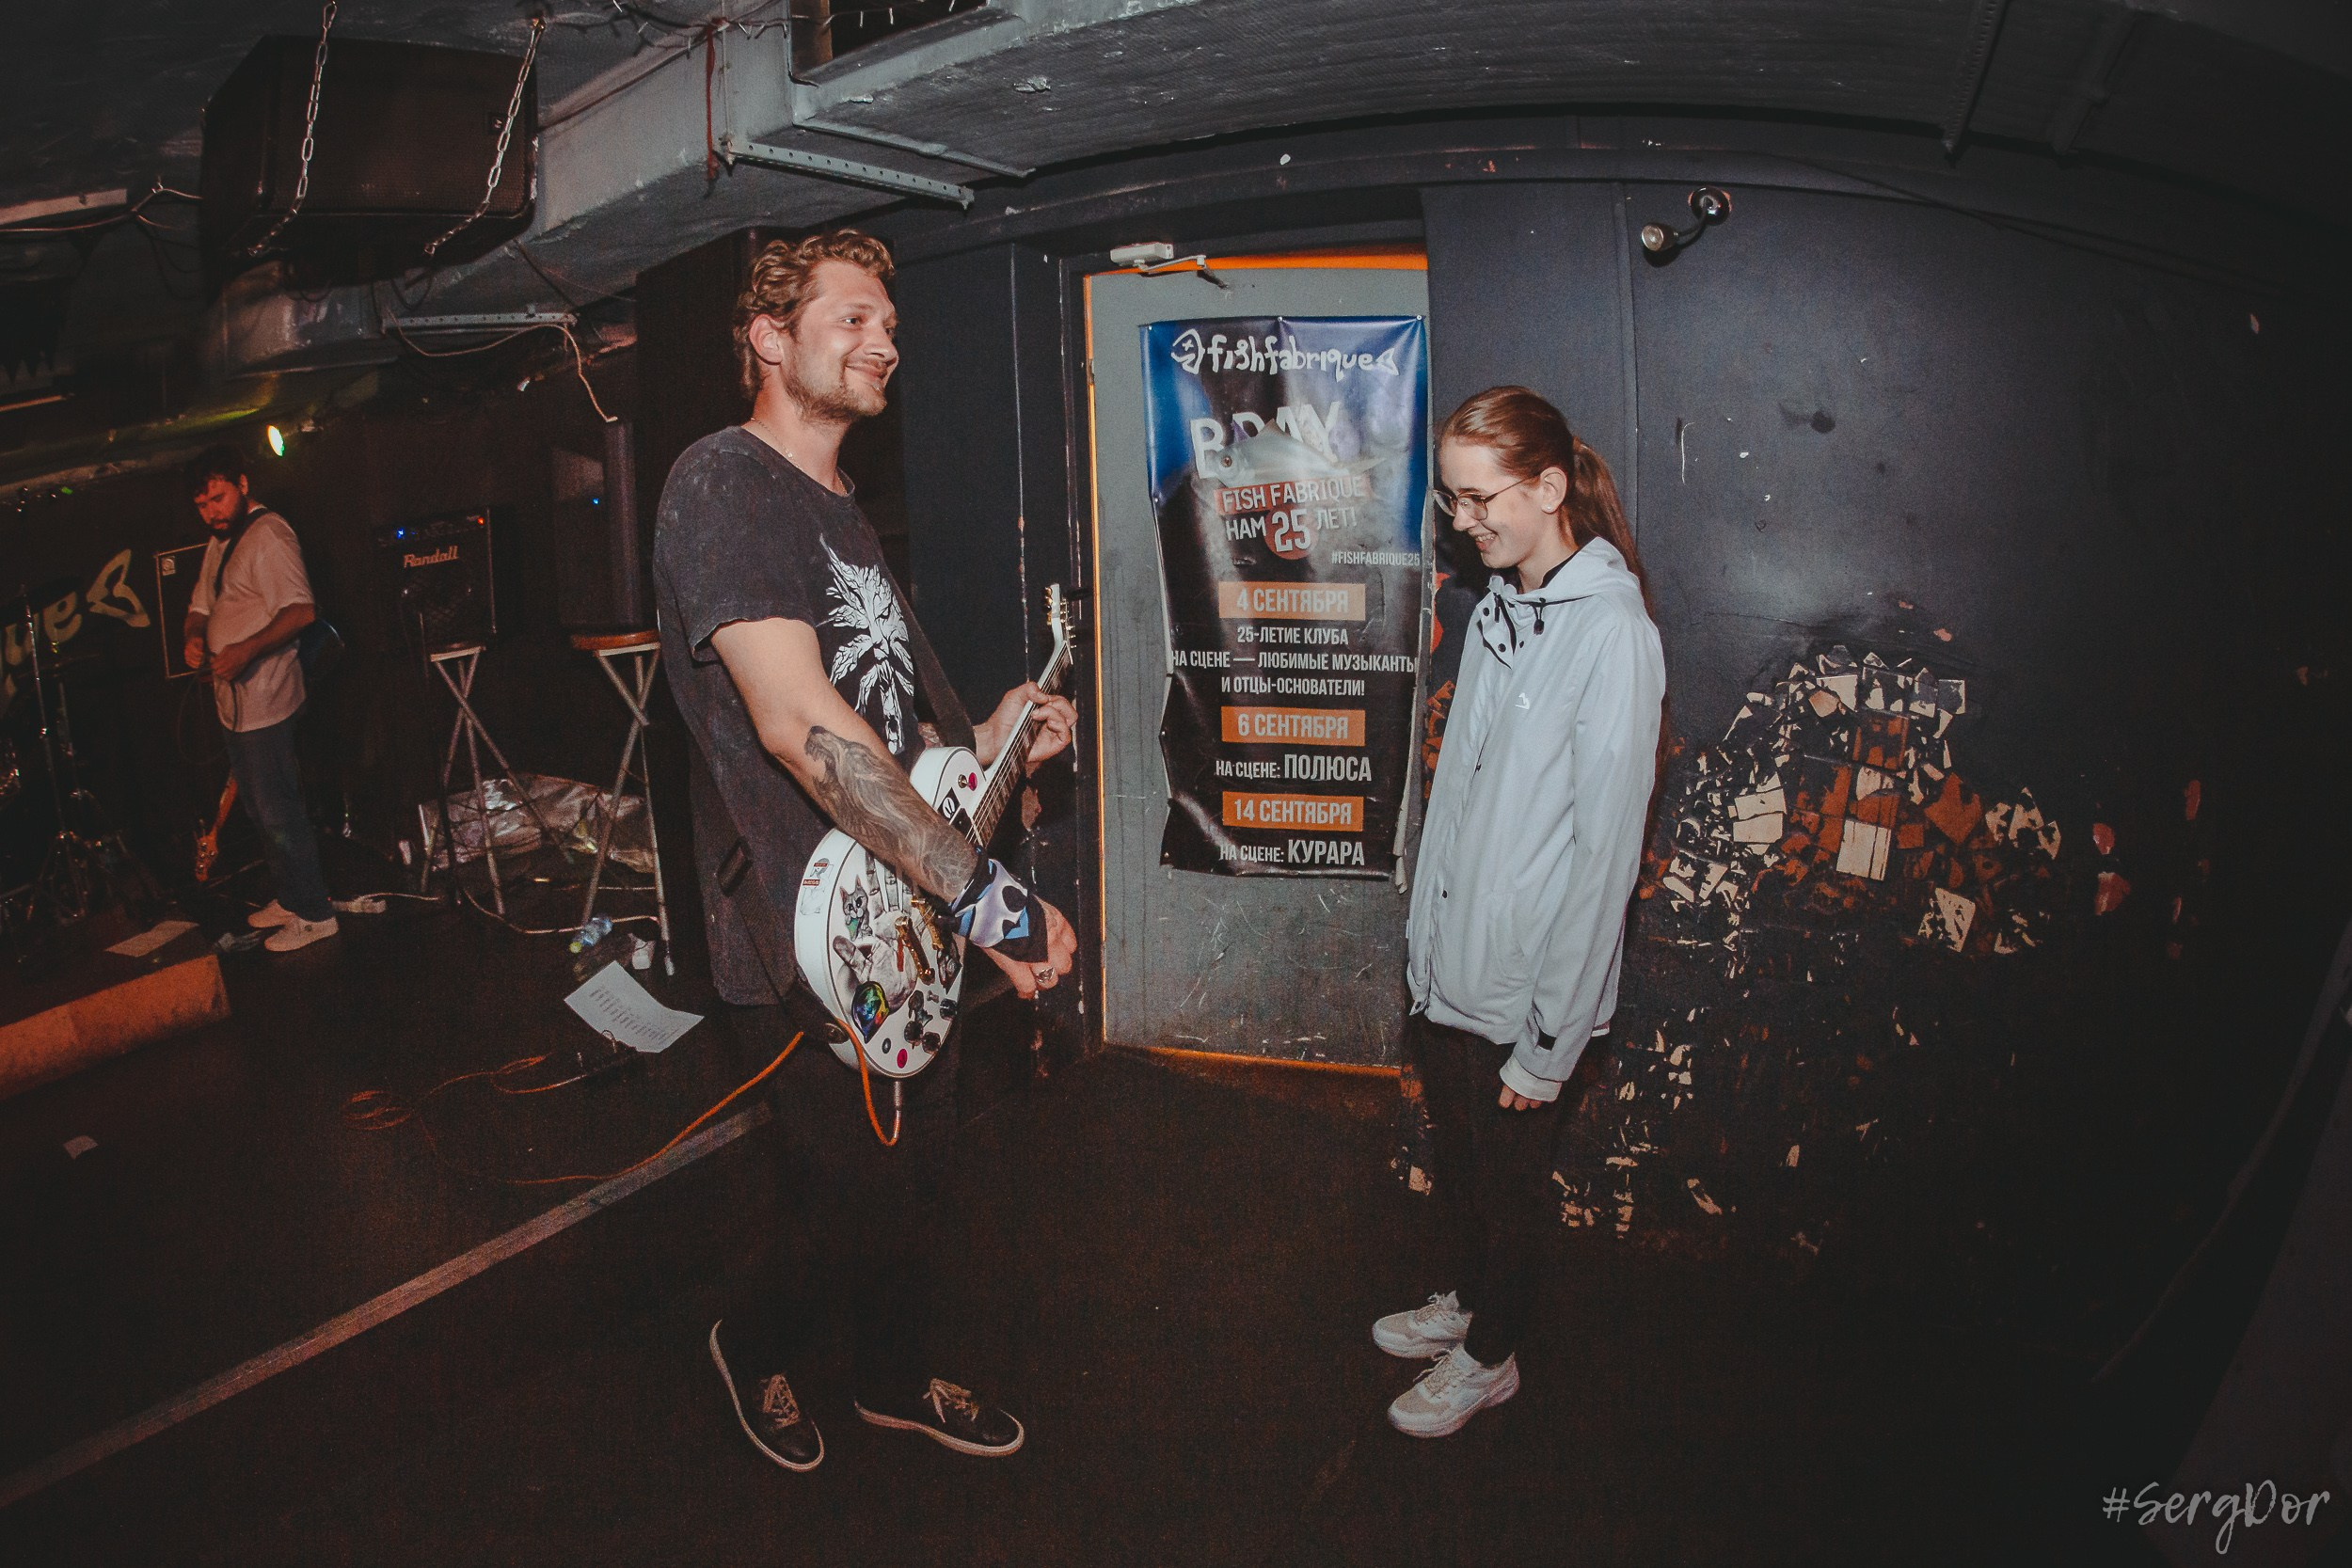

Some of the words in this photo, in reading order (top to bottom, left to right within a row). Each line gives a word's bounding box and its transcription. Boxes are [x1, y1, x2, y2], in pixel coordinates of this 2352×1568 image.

[1223, 487, 1266, 512] FISH
[1270, 475, 1365, 506] FABRIQUE
[1226, 515, 1267, 541] НАМ
[1271, 509, 1312, 552] 25
[1316, 506, 1358, 531] ЛЕТ!
[403, 545, 459, 569] Randall
[1330, 550, 1421, 566] #FISHFABRIQUE25
[1236, 587, 1248, 611] 4
[1253, 588, 1349, 613] СЕНТЯБРЯ
[1237, 626, 1301, 644] 25-ЛЕТИЕ
[1304, 627, 1349, 645] КЛУБА
[1190, 650, 1232, 669] СЦЕНЕ
[1258, 651, 1329, 671] ЛЮБИМЫЕ
[1332, 654, 1419, 673] МУЗЫКАНТЫ
[1221, 676, 1231, 693] И
[1233, 676, 1365, 696] ОТЦЫ-ОСНОВАТЕЛИ!
[1237, 713, 1250, 736] 6
[1254, 713, 1349, 739] СЕНТЯБРЯ
[1216, 760, 1233, 777] НА
[1235, 761, 1281, 780] СЦЕНЕ:
[1284, 753, 1373, 782] ПОЛЮСА
[1234, 799, 1256, 821] 14
[1259, 800, 1352, 825] СЕНТЯБРЯ
[1219, 845, 1237, 862] НА
[1240, 846, 1284, 863] СЦЕНЕ:
[1288, 839, 1365, 866] КУРАРА
